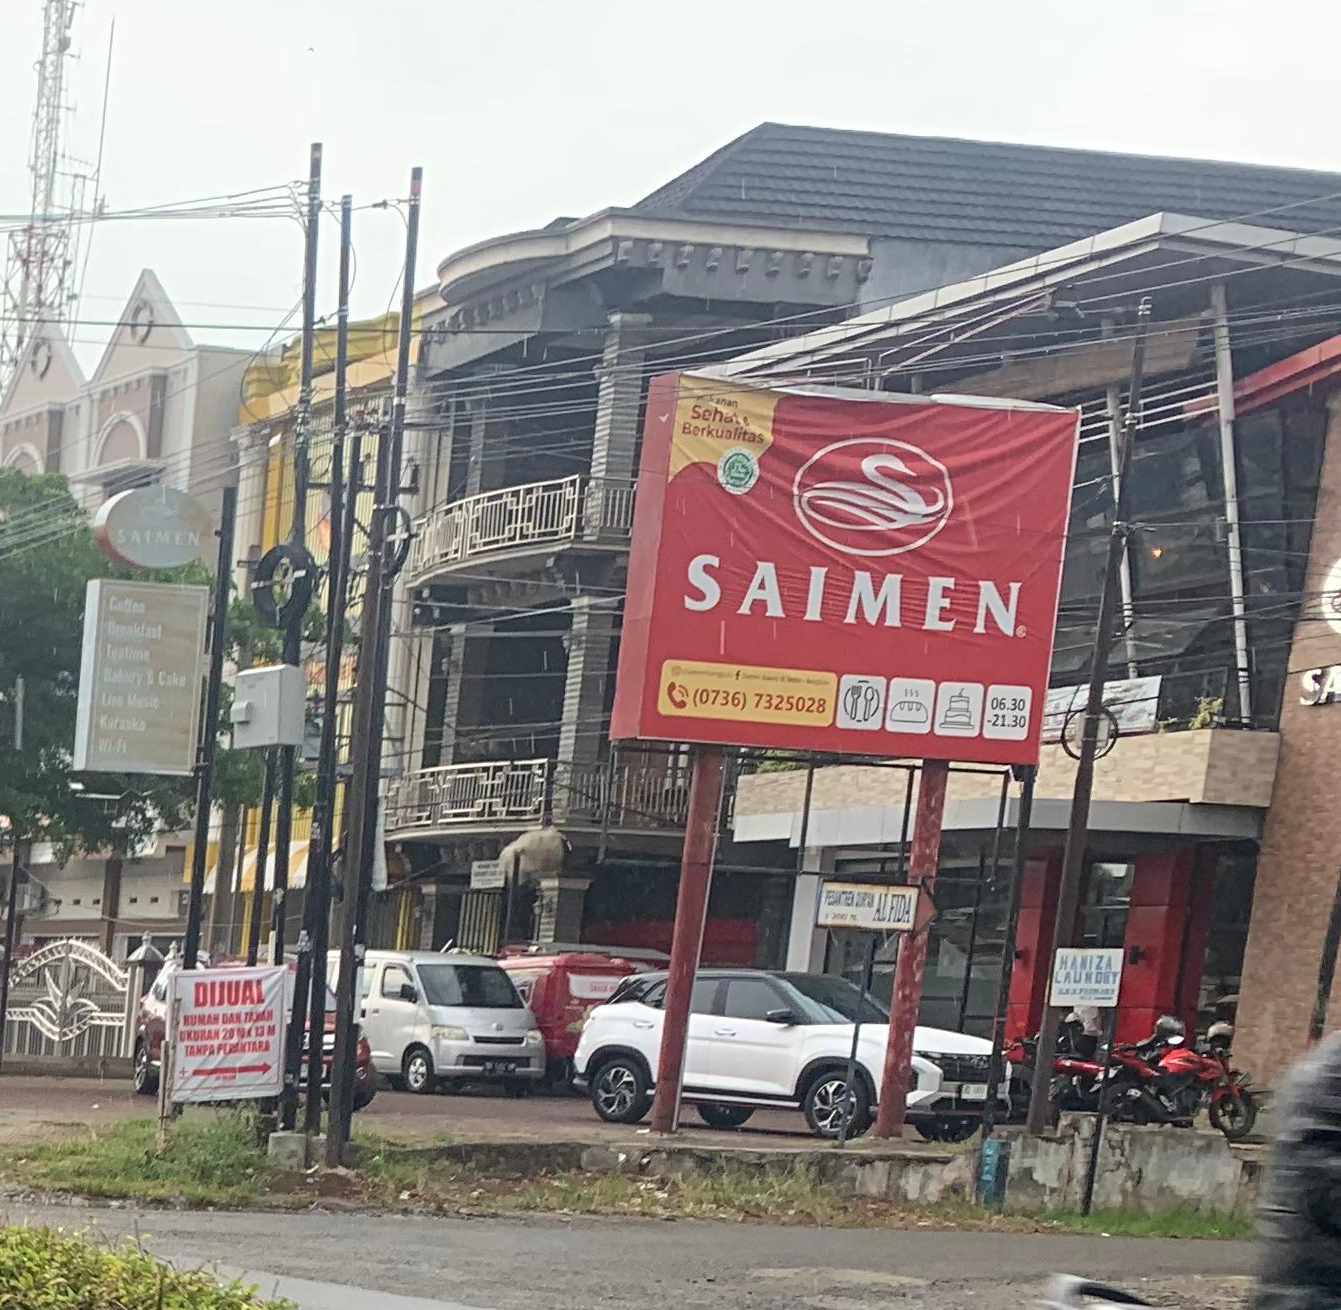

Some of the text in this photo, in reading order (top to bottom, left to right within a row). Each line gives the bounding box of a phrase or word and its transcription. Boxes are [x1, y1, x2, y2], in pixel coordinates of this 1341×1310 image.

[682, 422, 764, 444] Berkualitas
[117, 528, 200, 546] SAIMEN
[683, 554, 1023, 637] SAIMEN
[109, 596, 146, 614] Coffee
[107, 620, 162, 640] Breakfast
[106, 644, 150, 661] Teatime
[103, 667, 143, 687] Bakery
[158, 671, 186, 687] Cake
[127, 693, 160, 710] Music
[693, 688, 827, 714] (0736) 7325028
[991, 696, 1026, 712] 06.30
[99, 715, 146, 732] Karaoke
[987, 713, 1027, 730] -21.30
[1060, 955, 1113, 971] HANIZA
[1055, 971, 1119, 985] LAUNDRY
[194, 979, 265, 1007] DIJUAL
